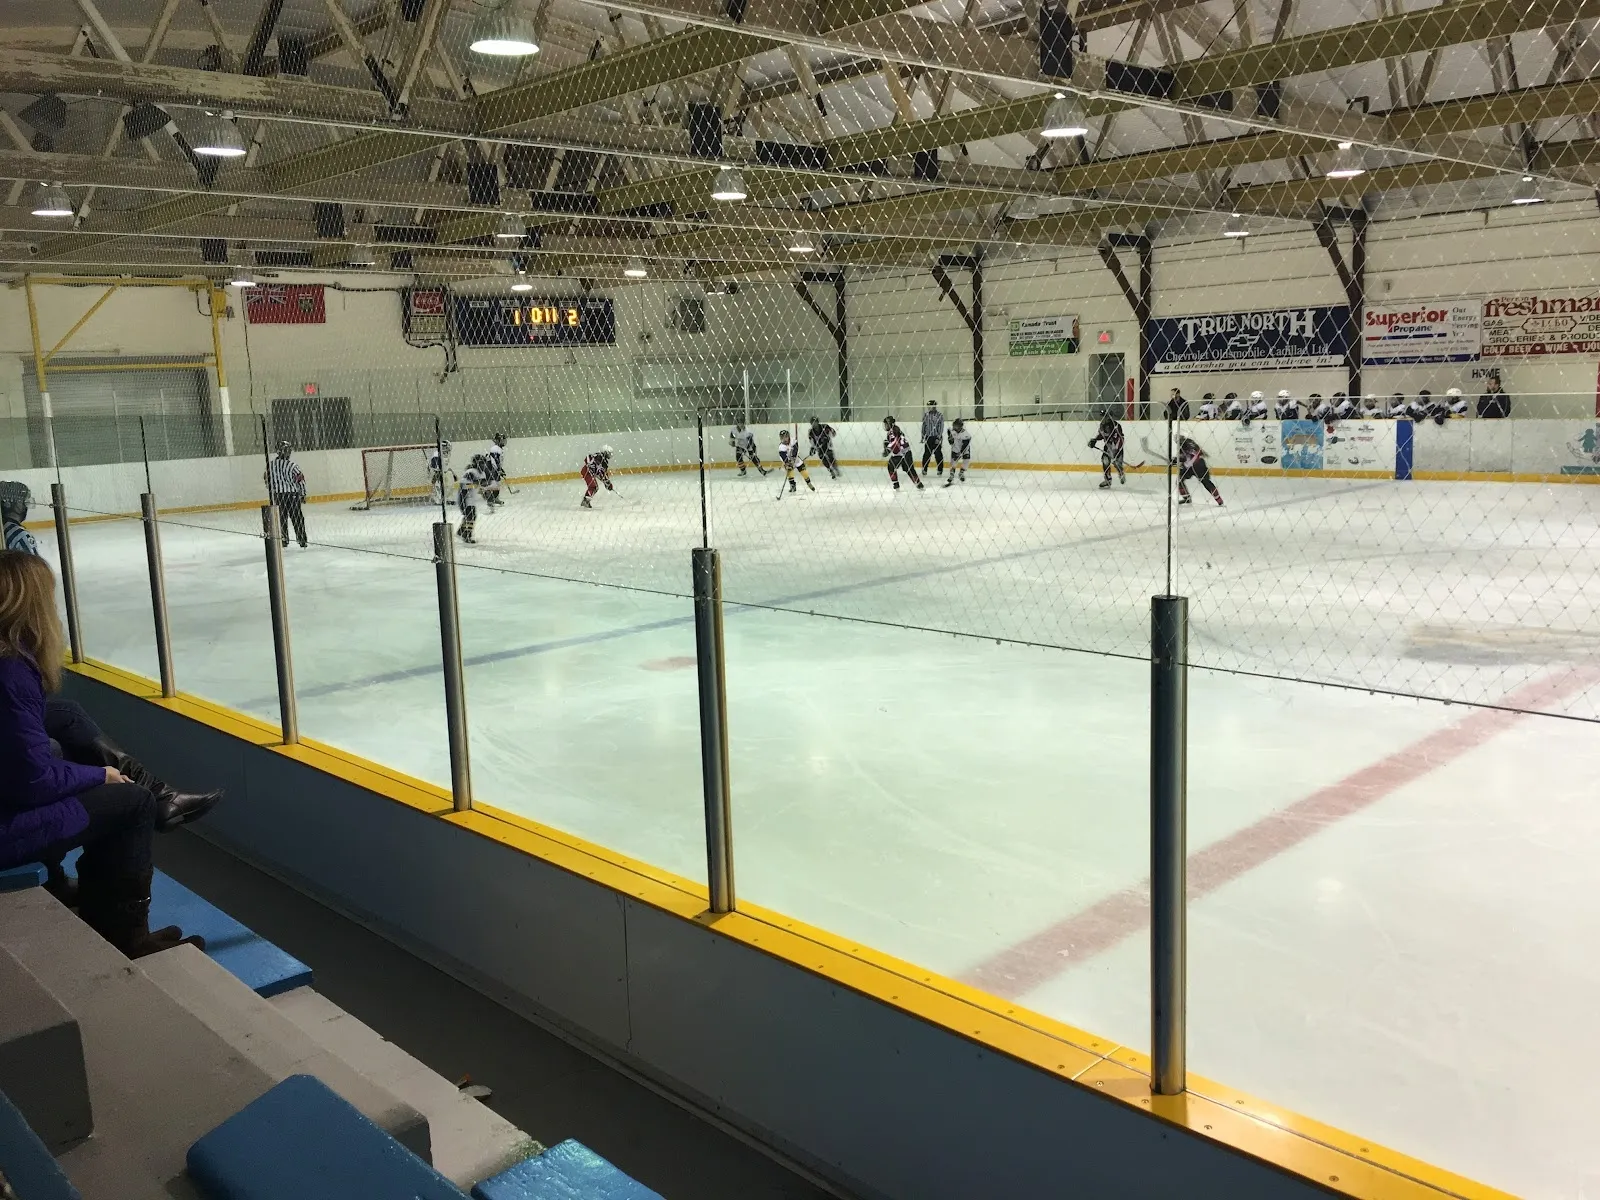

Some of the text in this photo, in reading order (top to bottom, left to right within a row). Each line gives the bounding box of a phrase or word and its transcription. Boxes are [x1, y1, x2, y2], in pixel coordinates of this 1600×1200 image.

[568, 309, 578, 325] 2
[1365, 306, 1449, 333] Superior
[1483, 319, 1504, 327] GAS
[1178, 310, 1316, 345] TRUE NORTH
[1393, 324, 1433, 334] Propane
[1489, 335, 1546, 344] GROCERIES
[1165, 343, 1332, 362] Chevrolet Oldsmobile Cadillac Ltd.
[1483, 345, 1505, 355] COLD
[1508, 344, 1532, 354] BEER
[1544, 343, 1569, 352] WINE
[1471, 368, 1501, 379] HOME
